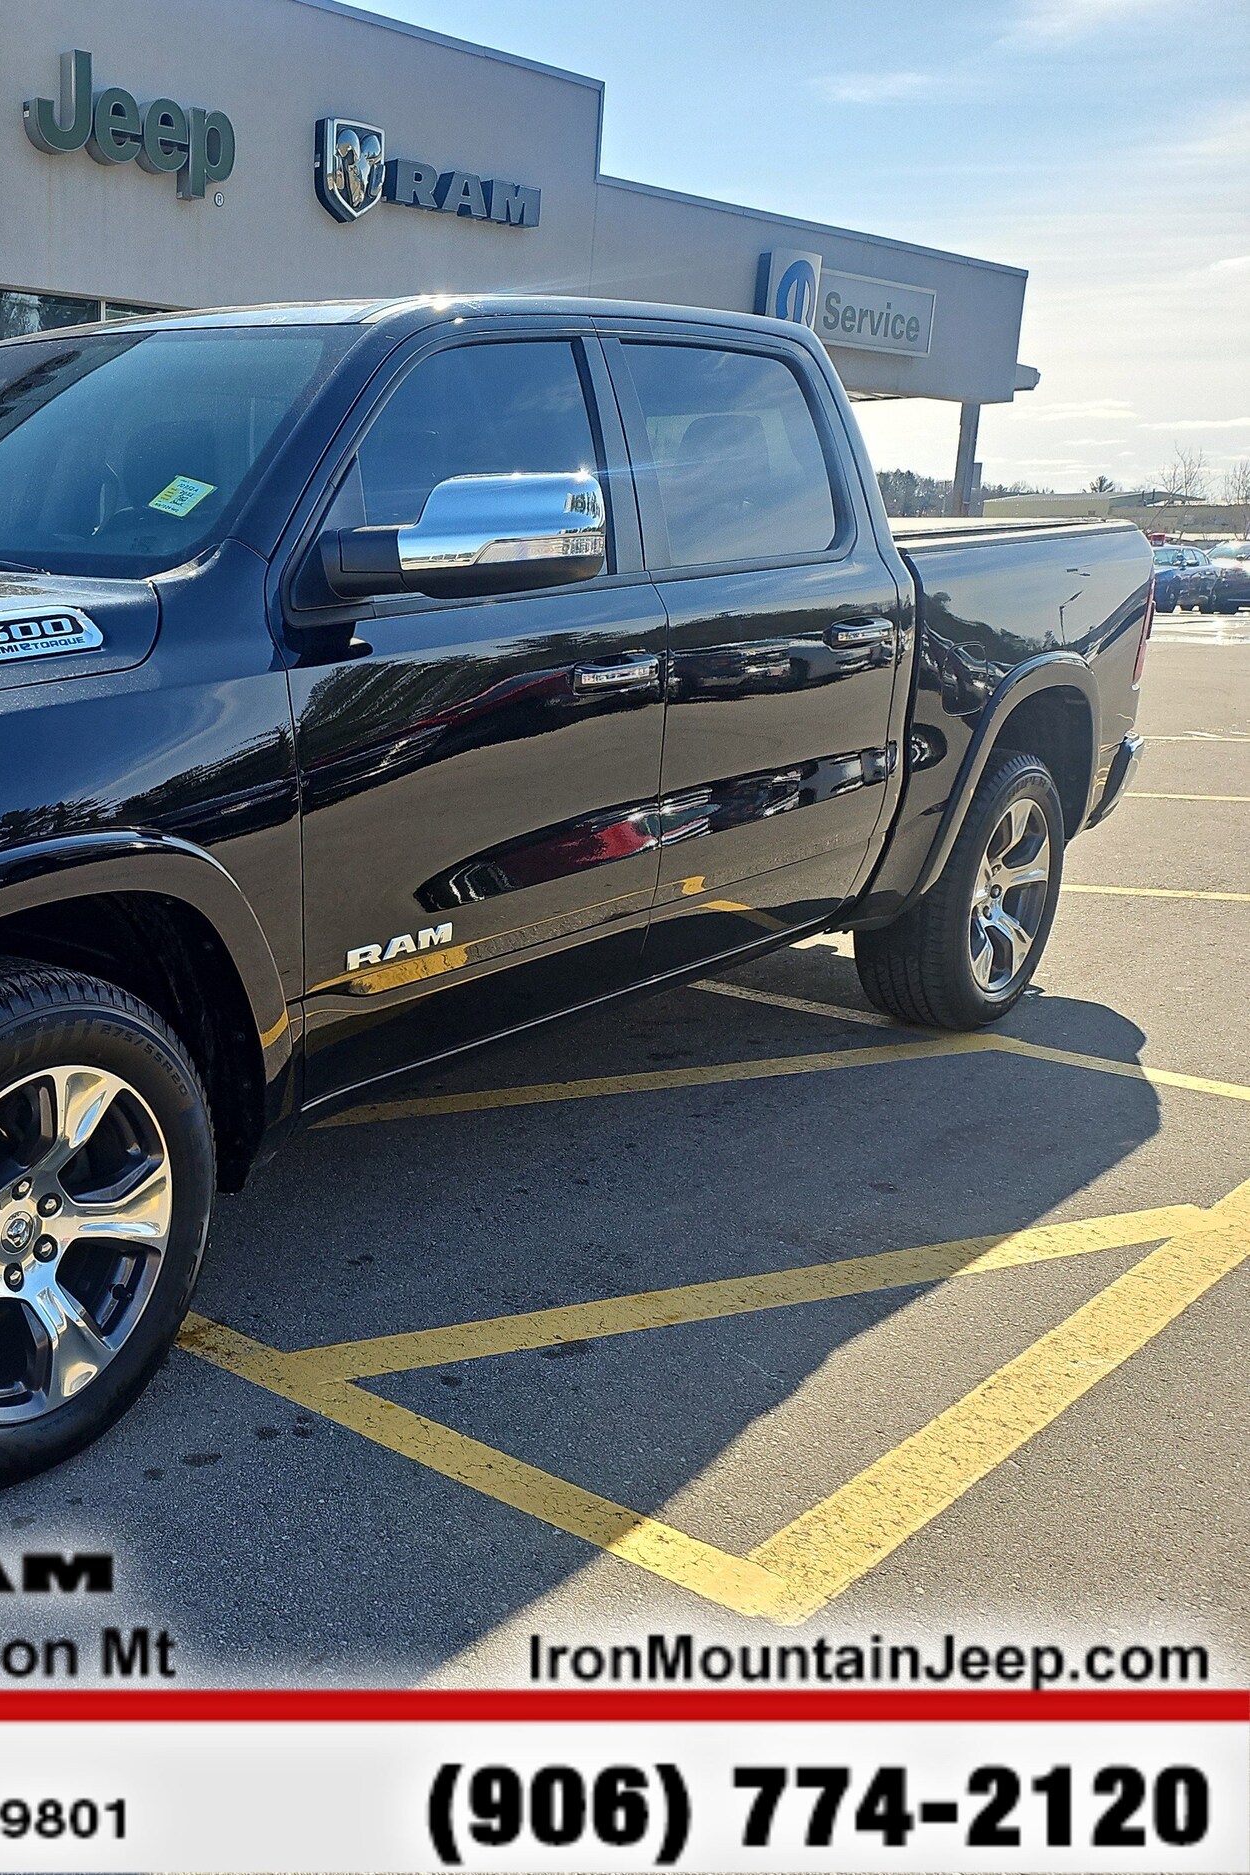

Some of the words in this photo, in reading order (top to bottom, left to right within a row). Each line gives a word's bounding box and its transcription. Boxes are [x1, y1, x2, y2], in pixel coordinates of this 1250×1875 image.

[23, 49, 235, 200] Jeep
[390, 158, 541, 228] RAM
[822, 291, 921, 342] Service
[346, 922, 453, 971] RAM
[100, 1023, 189, 1097] 275/55R20
